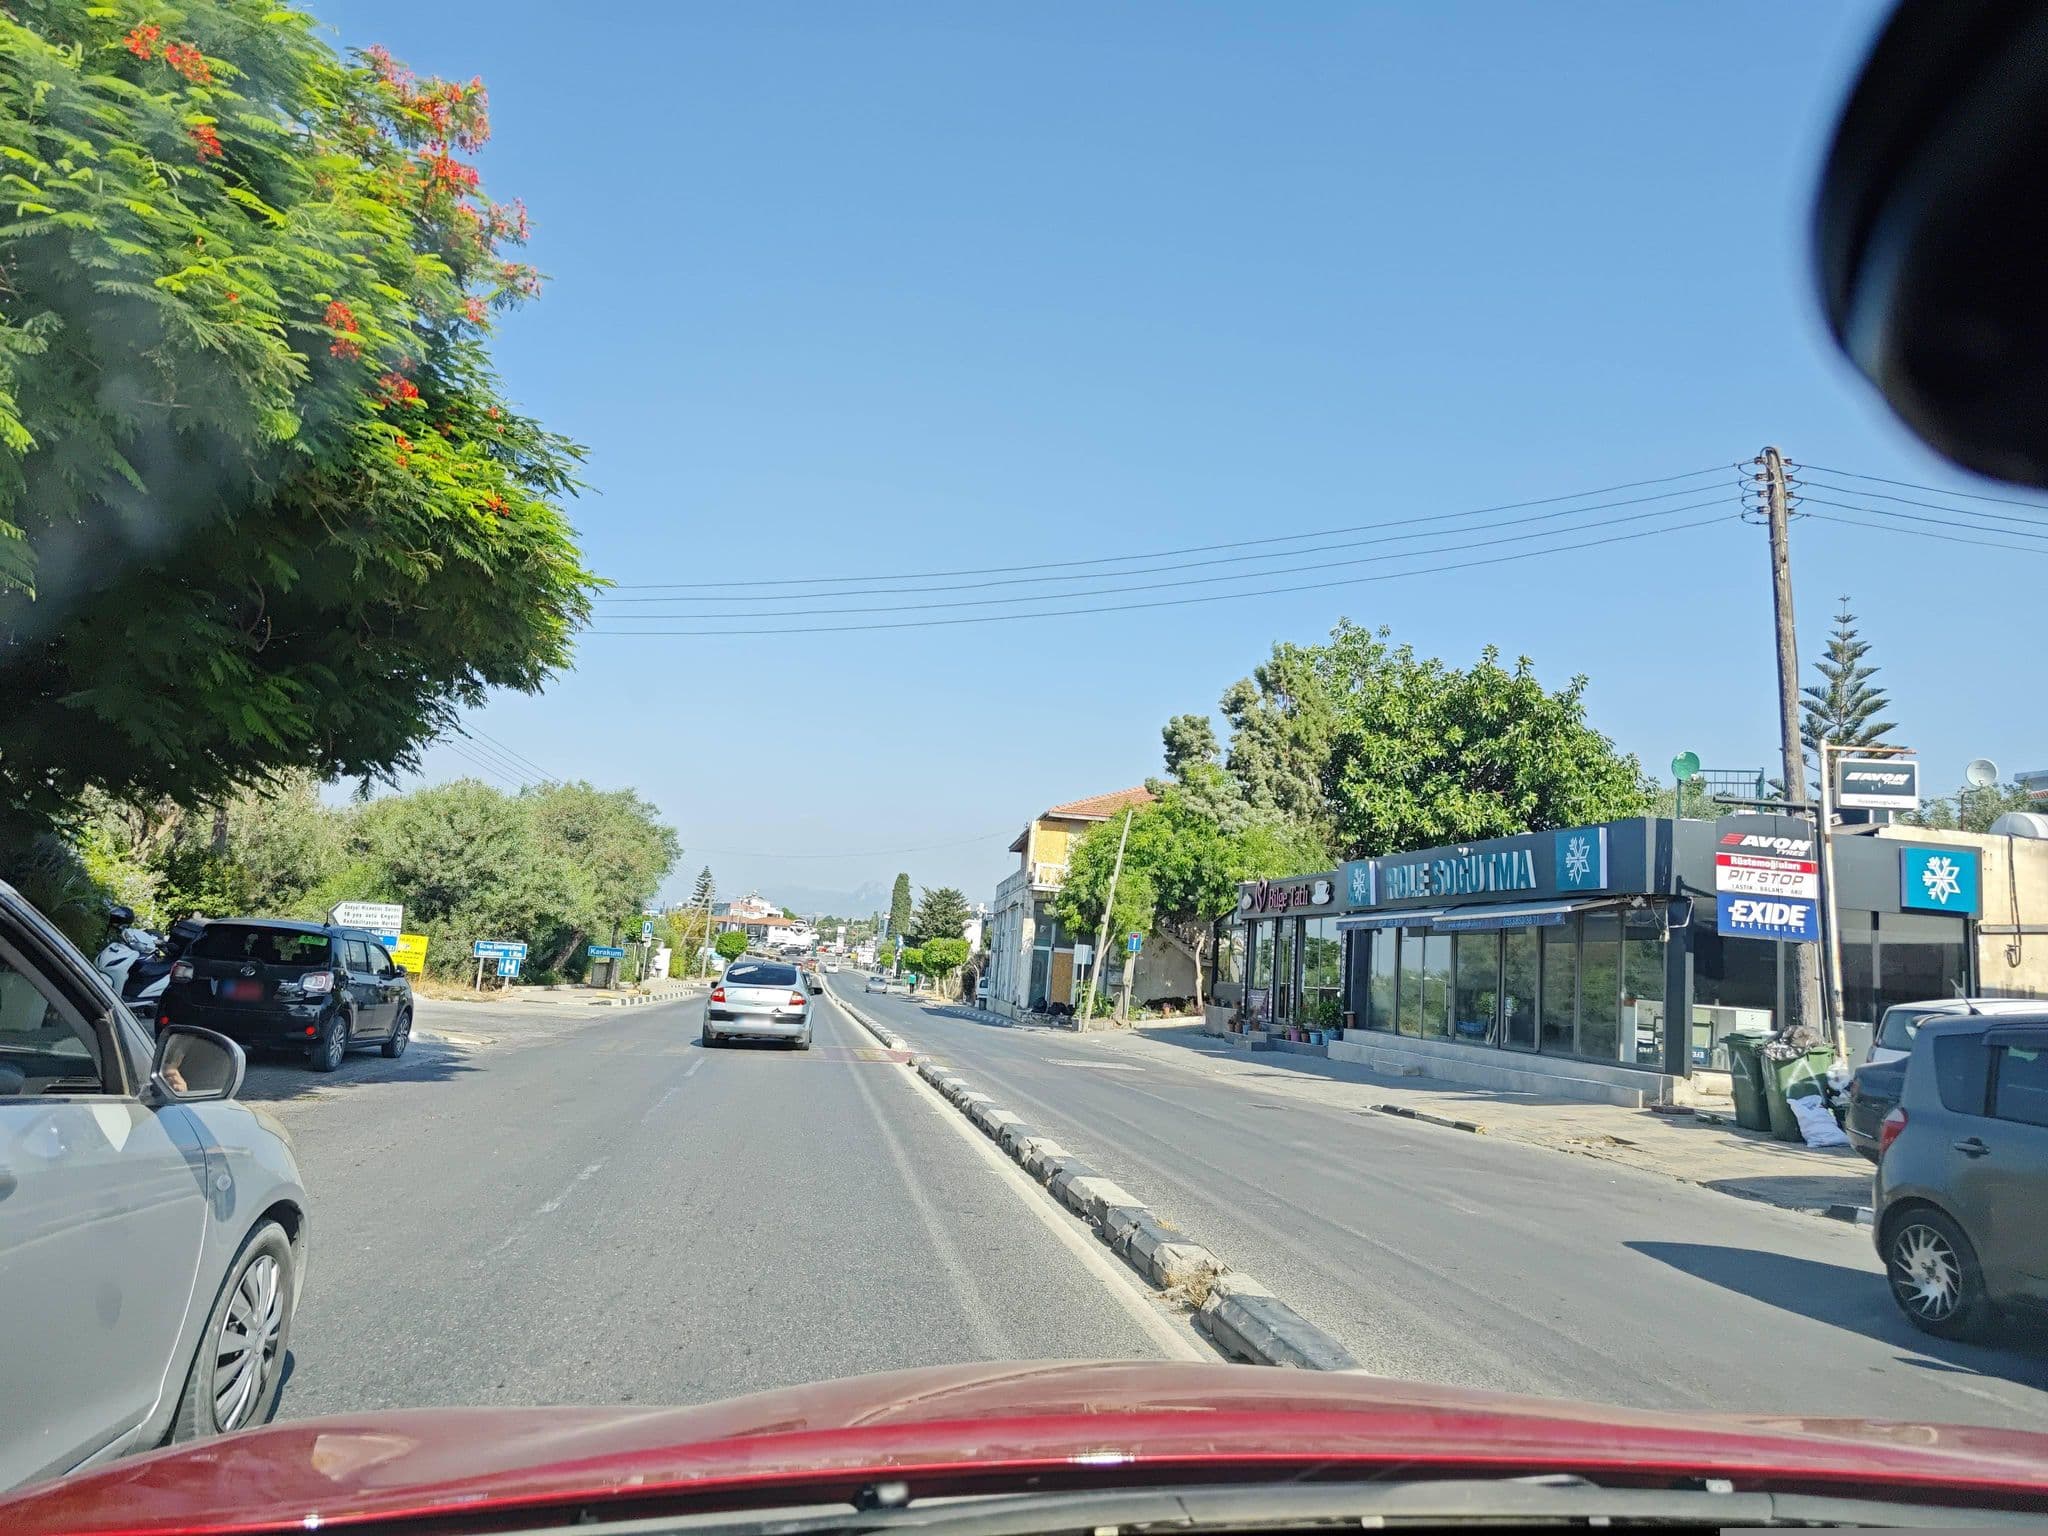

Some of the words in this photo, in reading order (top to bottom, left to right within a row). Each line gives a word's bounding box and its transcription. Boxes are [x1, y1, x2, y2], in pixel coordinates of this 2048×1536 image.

[1860, 773, 1910, 782] AVON
[1740, 835, 1813, 851] AVON
[1728, 870, 1755, 881] PIT
[1757, 872, 1804, 885] STOP
[1268, 888, 1287, 912] Bilge
[1728, 900, 1810, 927] EXIDE
[645, 922, 651, 932] D
[1732, 922, 1805, 934] BATTERIES
[590, 948, 621, 957] Karakum
[504, 960, 516, 973] H
